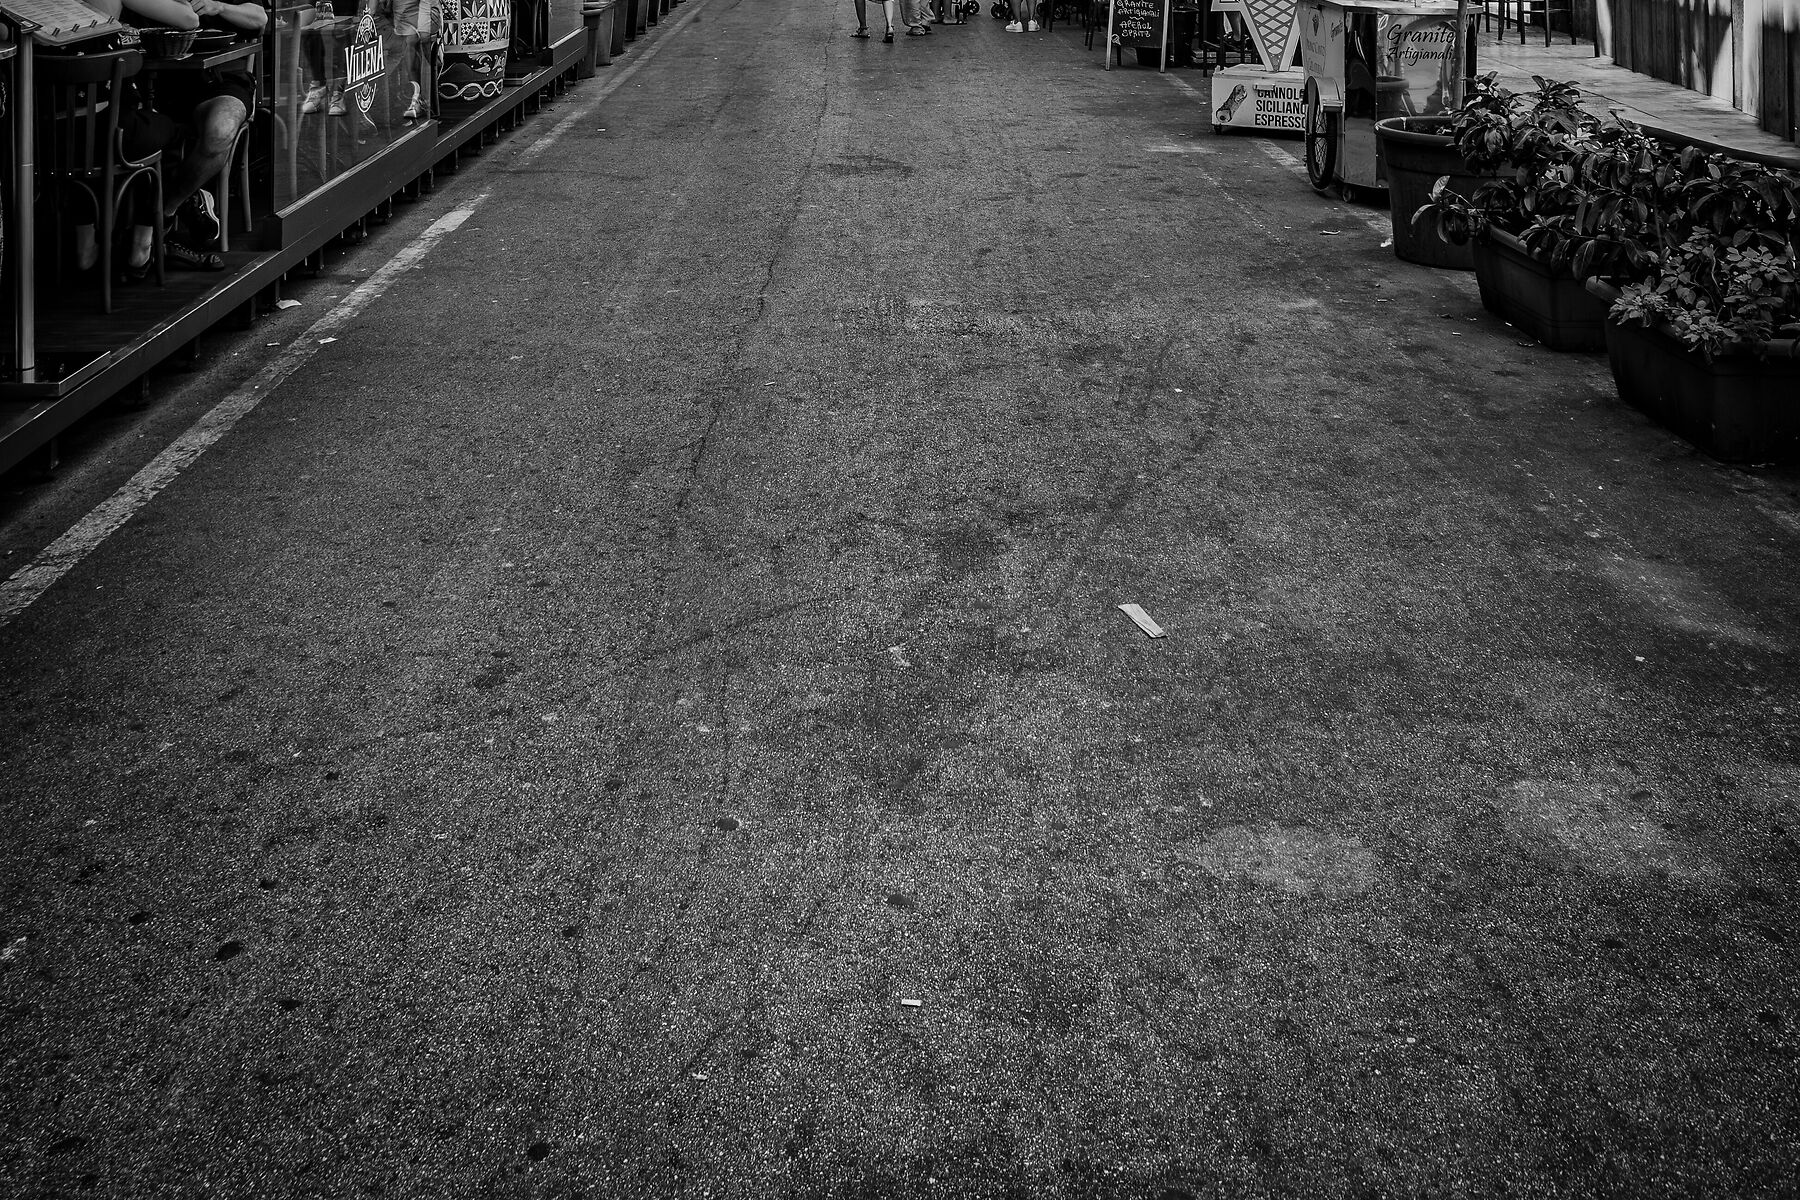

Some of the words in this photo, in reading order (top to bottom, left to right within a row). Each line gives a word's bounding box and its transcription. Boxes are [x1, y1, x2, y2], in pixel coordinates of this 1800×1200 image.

[1119, 20, 1152, 30] APEROL
[1121, 29, 1151, 38] SPRITZ
[1387, 24, 1455, 45] Granite
[344, 34, 385, 85] VILLENA
[1386, 45, 1454, 67] Artigianali
